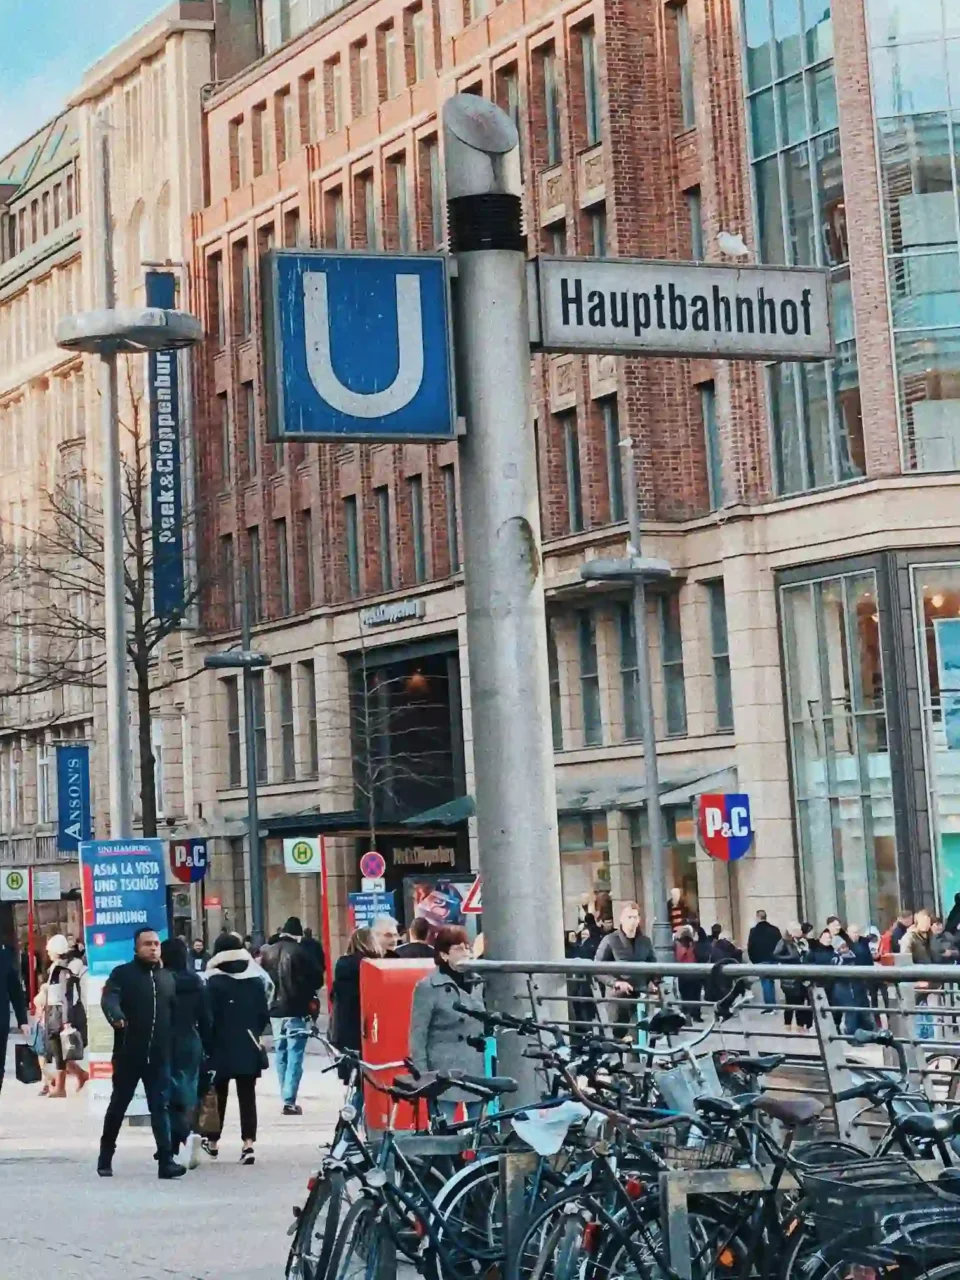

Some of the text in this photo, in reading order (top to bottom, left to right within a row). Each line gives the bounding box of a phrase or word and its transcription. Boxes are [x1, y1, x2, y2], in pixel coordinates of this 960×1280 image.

[560, 278, 812, 336] Hauptbahnhof
[303, 272, 424, 418] U
[153, 350, 176, 543] Peek&Cloppenbur
[705, 806, 749, 838] P&C
[120, 862, 133, 875] LA
[136, 861, 160, 875] VISTA
[175, 845, 205, 867] P&C
[94, 875, 159, 892] UND TSCHÜSS
[95, 895, 123, 908] FREIE
